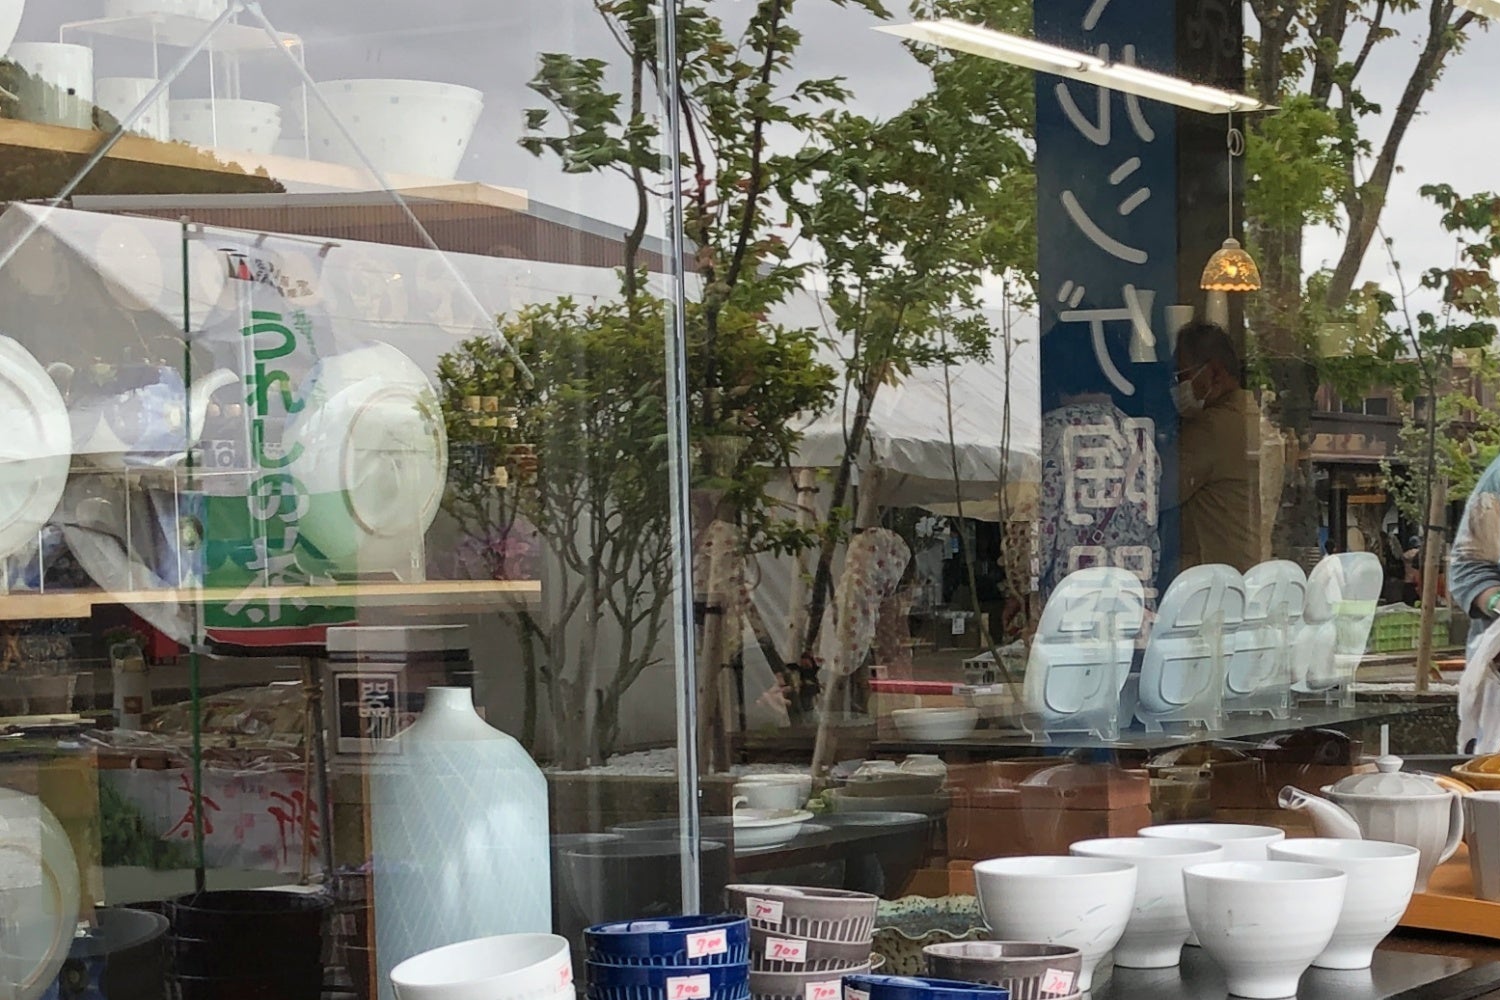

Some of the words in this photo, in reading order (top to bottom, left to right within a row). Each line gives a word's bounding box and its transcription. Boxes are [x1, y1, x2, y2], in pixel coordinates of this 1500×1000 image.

[696, 937, 722, 951] 700
[773, 943, 799, 958] 700
[675, 984, 700, 998] 700
[813, 987, 836, 1000] 700
